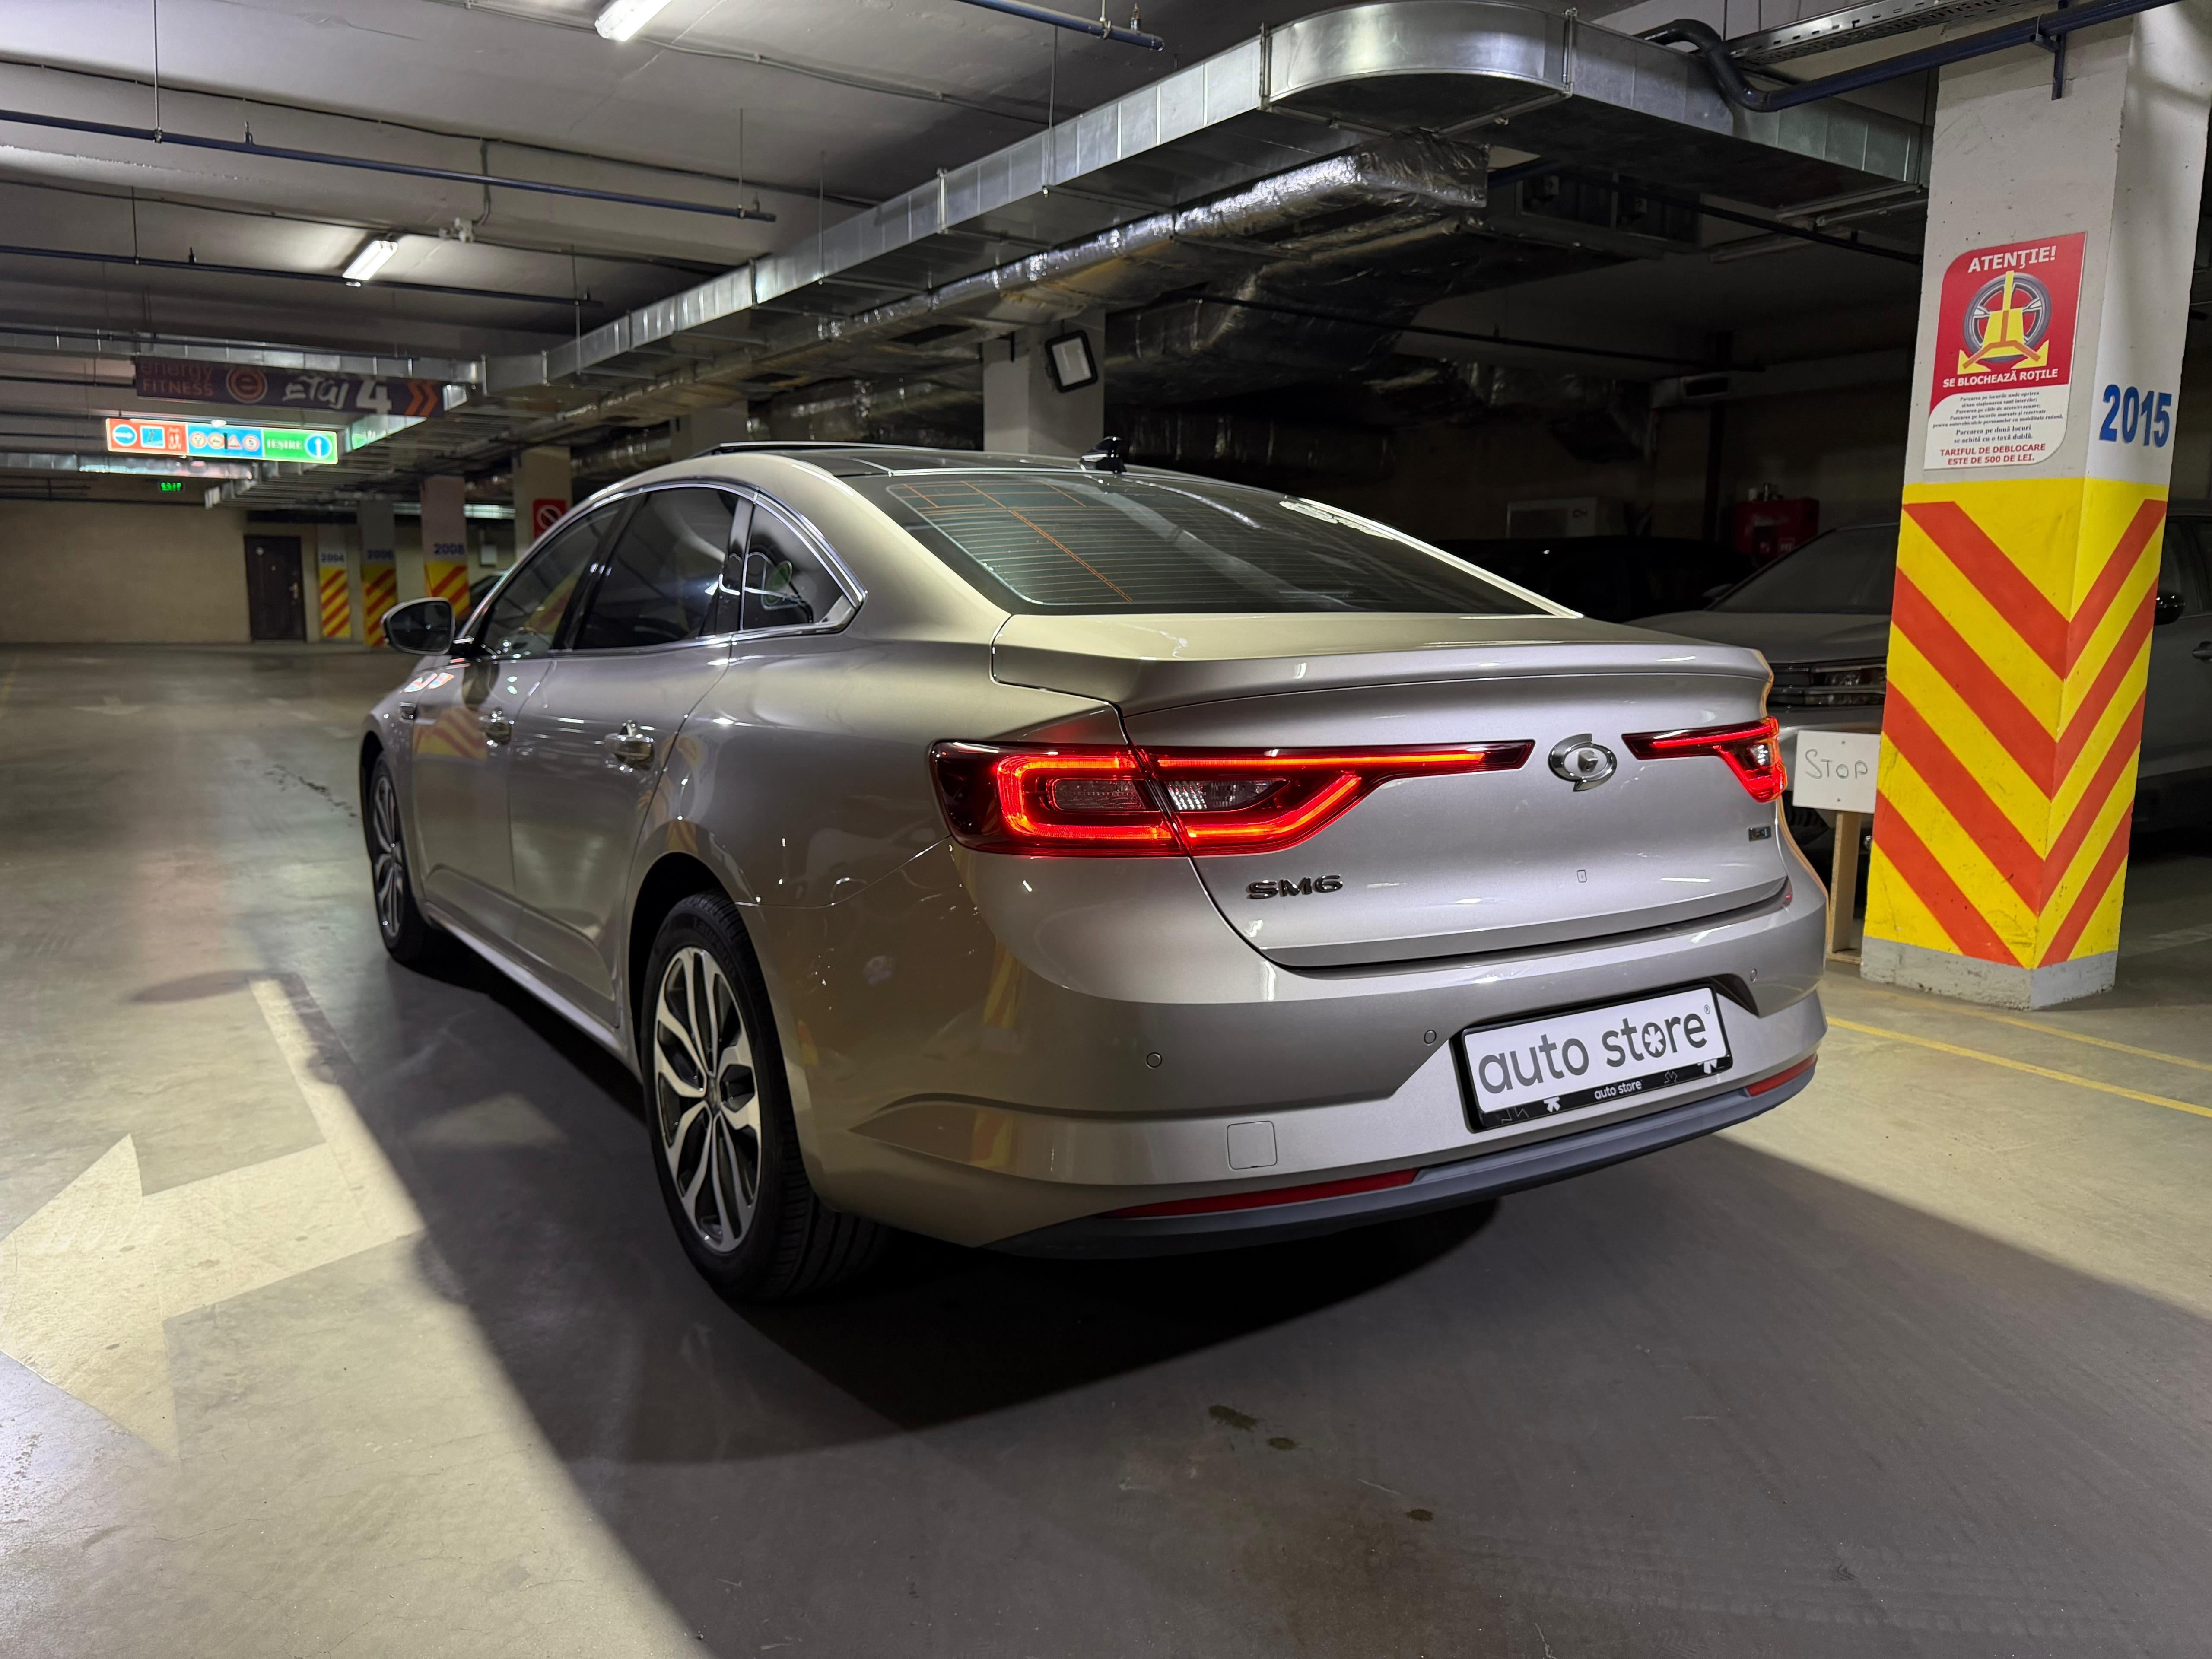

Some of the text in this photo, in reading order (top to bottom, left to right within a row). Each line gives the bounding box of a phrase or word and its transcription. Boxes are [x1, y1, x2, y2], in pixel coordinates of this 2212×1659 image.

[141, 362, 213, 384] energy
[1943, 378, 1955, 388] SE
[1957, 370, 2017, 386] BLOCHEAZĂ
[142, 378, 214, 396] FITNESS
[356, 377, 392, 414] 4
[2099, 384, 2172, 448] 2015
[1940, 443, 2046, 456] TARIFUL DE DEBLOCARE
[1948, 457, 1969, 465] ESTE
[1984, 455, 2001, 464] 500
[2003, 454, 2015, 462] DE
[2017, 453, 2035, 462] LEI.
[1247, 874, 1343, 899] SM6
[1478, 1033, 1589, 1094] auto
[1594, 1081, 1642, 1100] auto store
